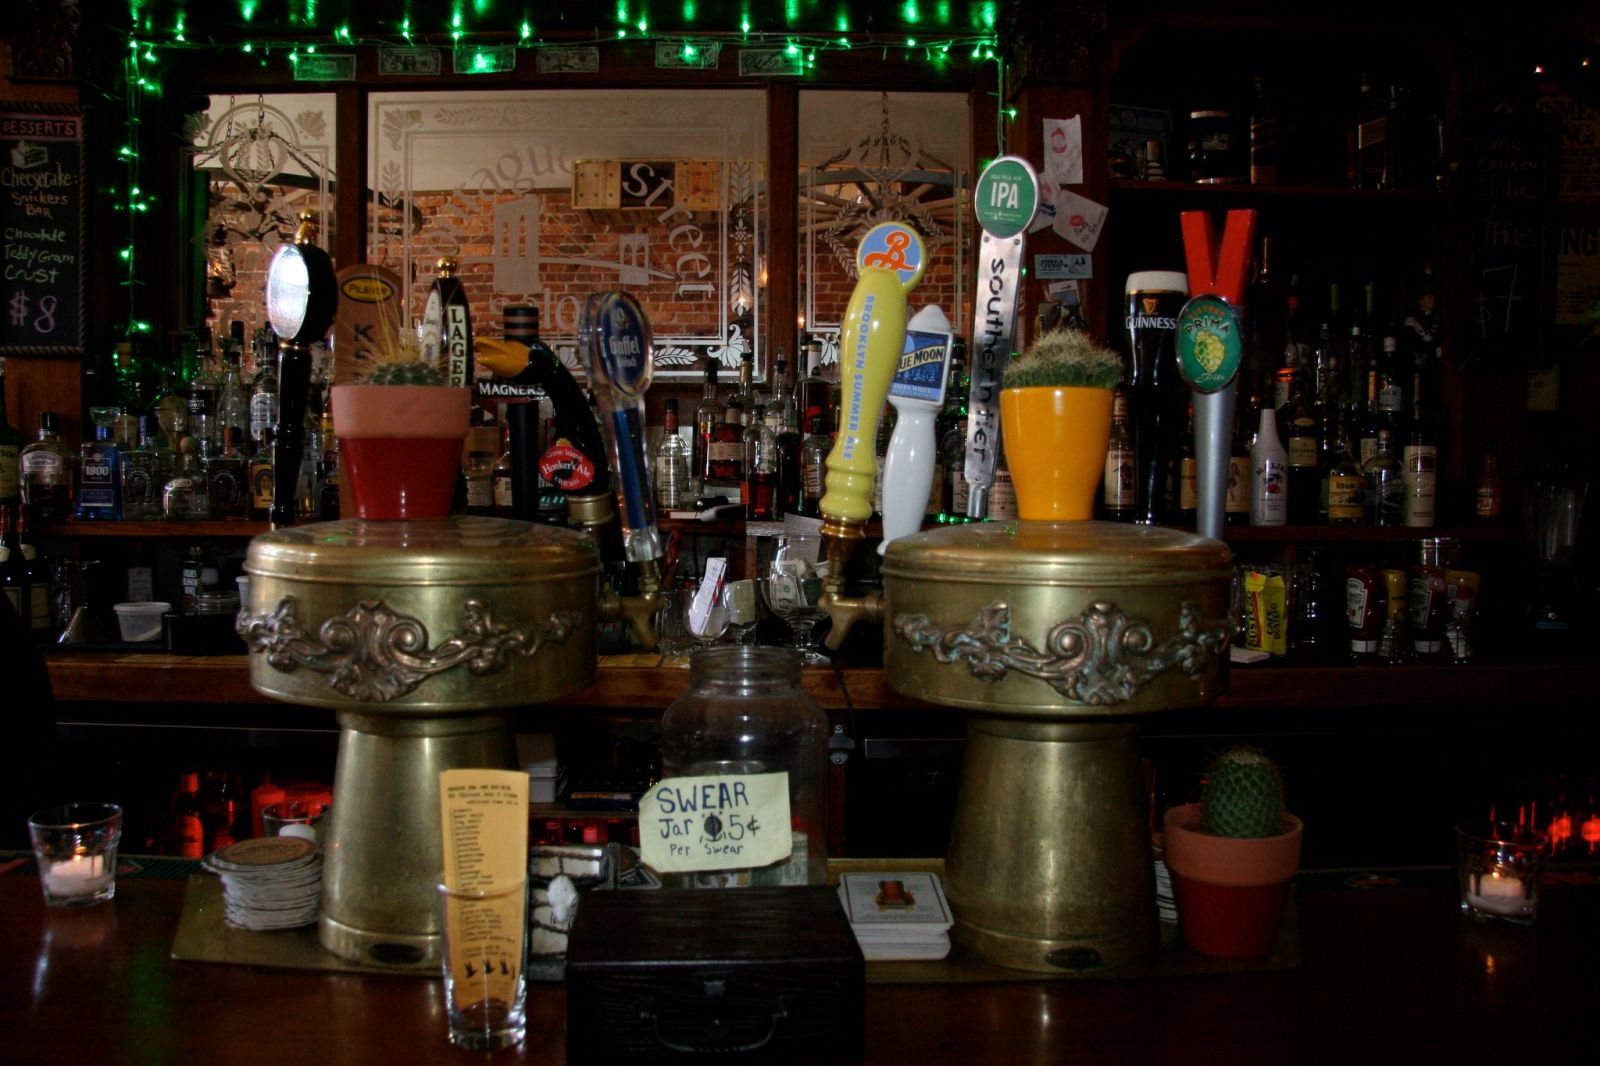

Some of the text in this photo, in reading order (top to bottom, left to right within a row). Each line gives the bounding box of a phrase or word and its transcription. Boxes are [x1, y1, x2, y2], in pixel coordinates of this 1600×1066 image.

[3, 120, 75, 136] DESSERTS
[11, 191, 69, 206] Snickers
[991, 182, 1018, 209] IPA
[4, 227, 66, 242] Chocolate
[622, 163, 715, 301] Street
[4, 265, 60, 284] Crust
[1125, 315, 1176, 331] GUINNESS
[1185, 317, 1230, 335] PRIMA
[450, 309, 465, 387] LAGER
[609, 335, 640, 356] Gaffel
[913, 348, 945, 365] MOON
[842, 294, 876, 461] BROOKLYN SUMMER ALE
[479, 381, 547, 396] MAGNERS
[86, 466, 109, 477] 1800
[542, 459, 592, 478] Honker's Ale
[656, 781, 749, 814] SWEAR
[659, 818, 693, 839] Jar
[670, 843, 744, 856] Per Swear
